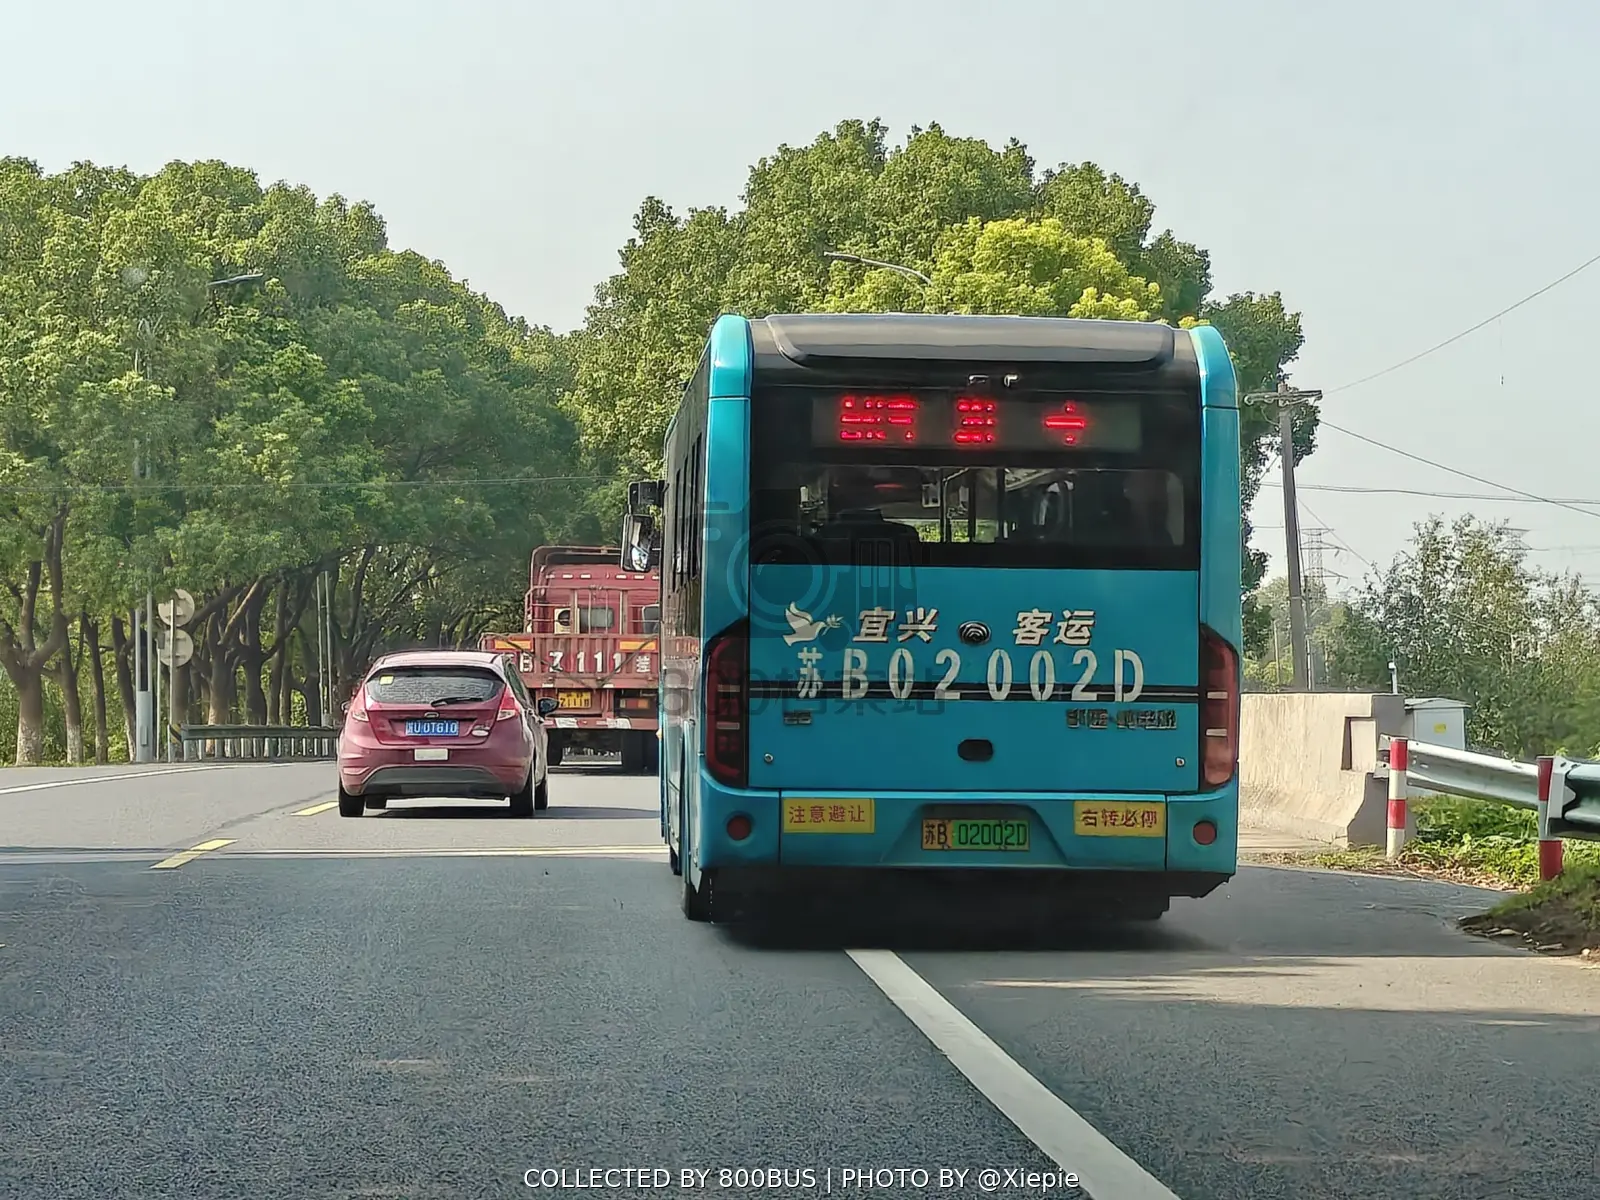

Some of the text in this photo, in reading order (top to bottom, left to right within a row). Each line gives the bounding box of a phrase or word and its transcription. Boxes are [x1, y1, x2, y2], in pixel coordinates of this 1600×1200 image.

[853, 606, 1096, 646] 宜兴 客运
[797, 648, 1145, 703] 苏B02002D
[788, 804, 866, 824] 注意避让
